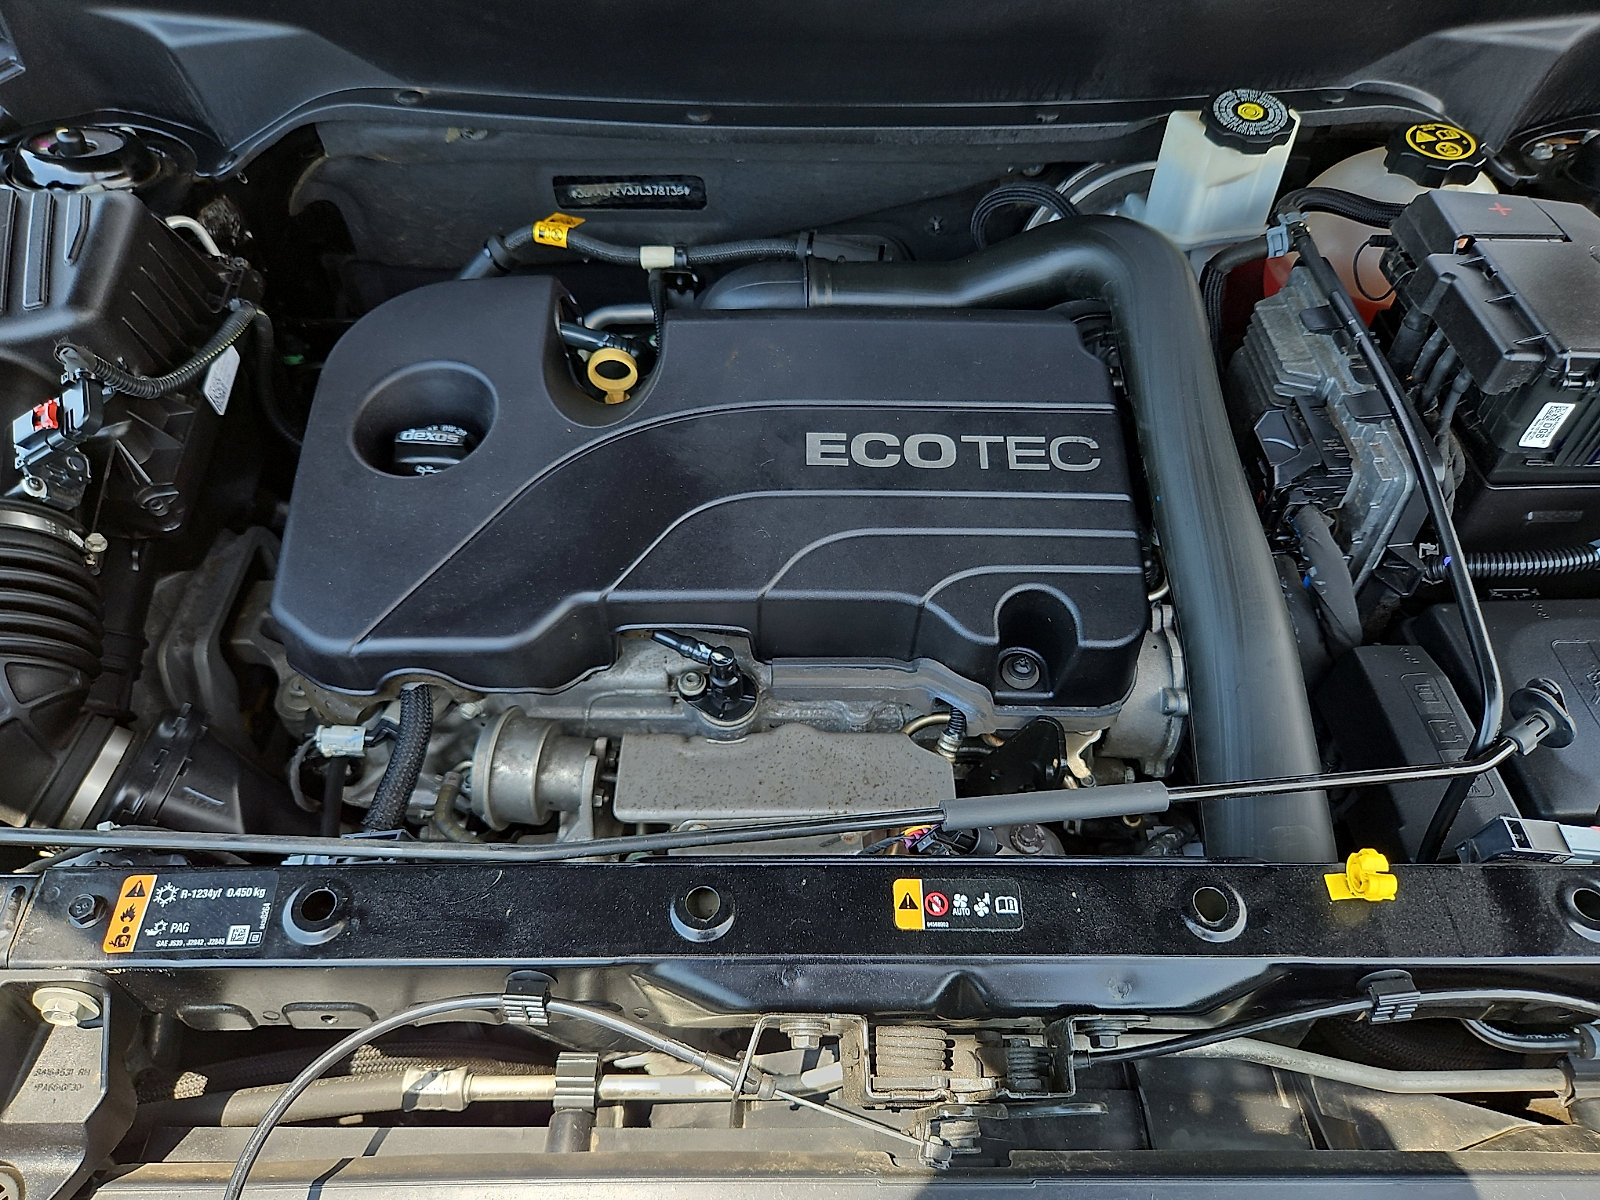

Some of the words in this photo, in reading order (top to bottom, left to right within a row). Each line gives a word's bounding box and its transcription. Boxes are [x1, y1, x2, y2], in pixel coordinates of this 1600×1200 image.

[400, 428, 460, 443] dexos
[805, 432, 1101, 472] ECOTEC
[180, 887, 223, 900] R-1234yf
[226, 887, 253, 898] 0.450
[253, 886, 267, 899] kg
[952, 907, 971, 917] AUTO
[169, 922, 191, 934] PAG
[155, 939, 169, 948] SAE
